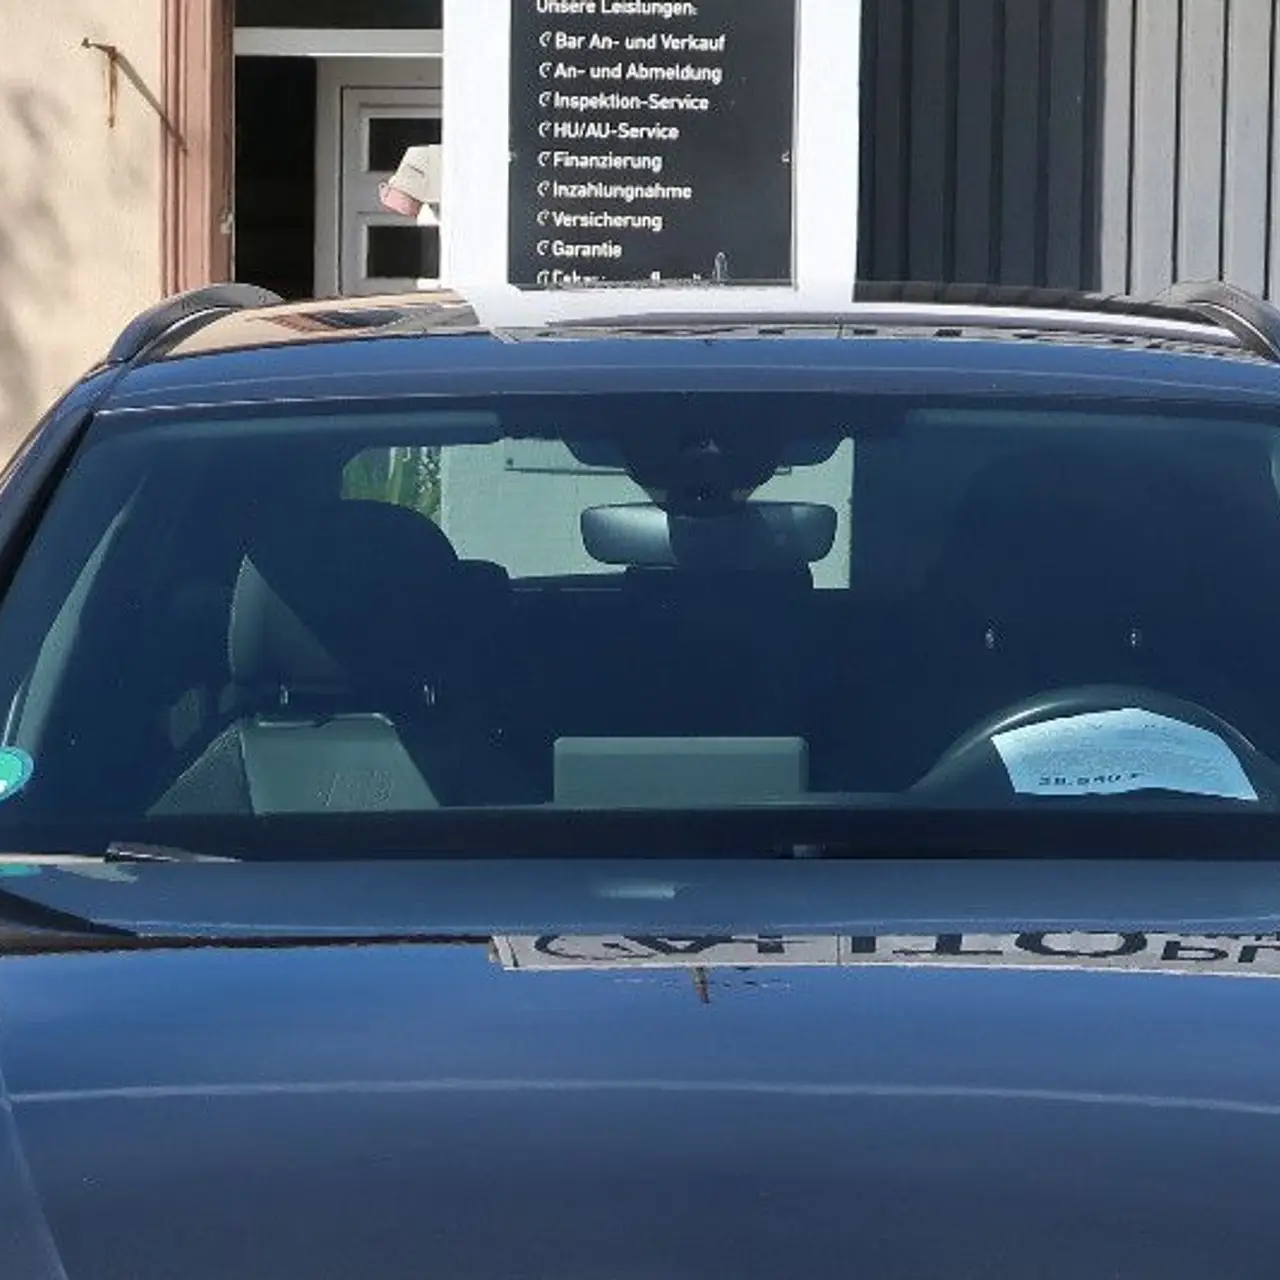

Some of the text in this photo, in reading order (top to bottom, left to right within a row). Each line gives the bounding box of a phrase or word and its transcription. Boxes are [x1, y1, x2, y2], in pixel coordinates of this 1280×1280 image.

[555, 31, 726, 51] Bar An- und Verkauf
[554, 62, 723, 85] An- und Abmeldung
[554, 91, 709, 111] Inspektion-Service
[553, 122, 680, 140] HU/AU-Service
[553, 151, 663, 172] Finanzierung
[553, 182, 692, 202] Inzahlungnahme
[552, 211, 663, 232] Versicherung
[552, 240, 622, 258] Garantie
